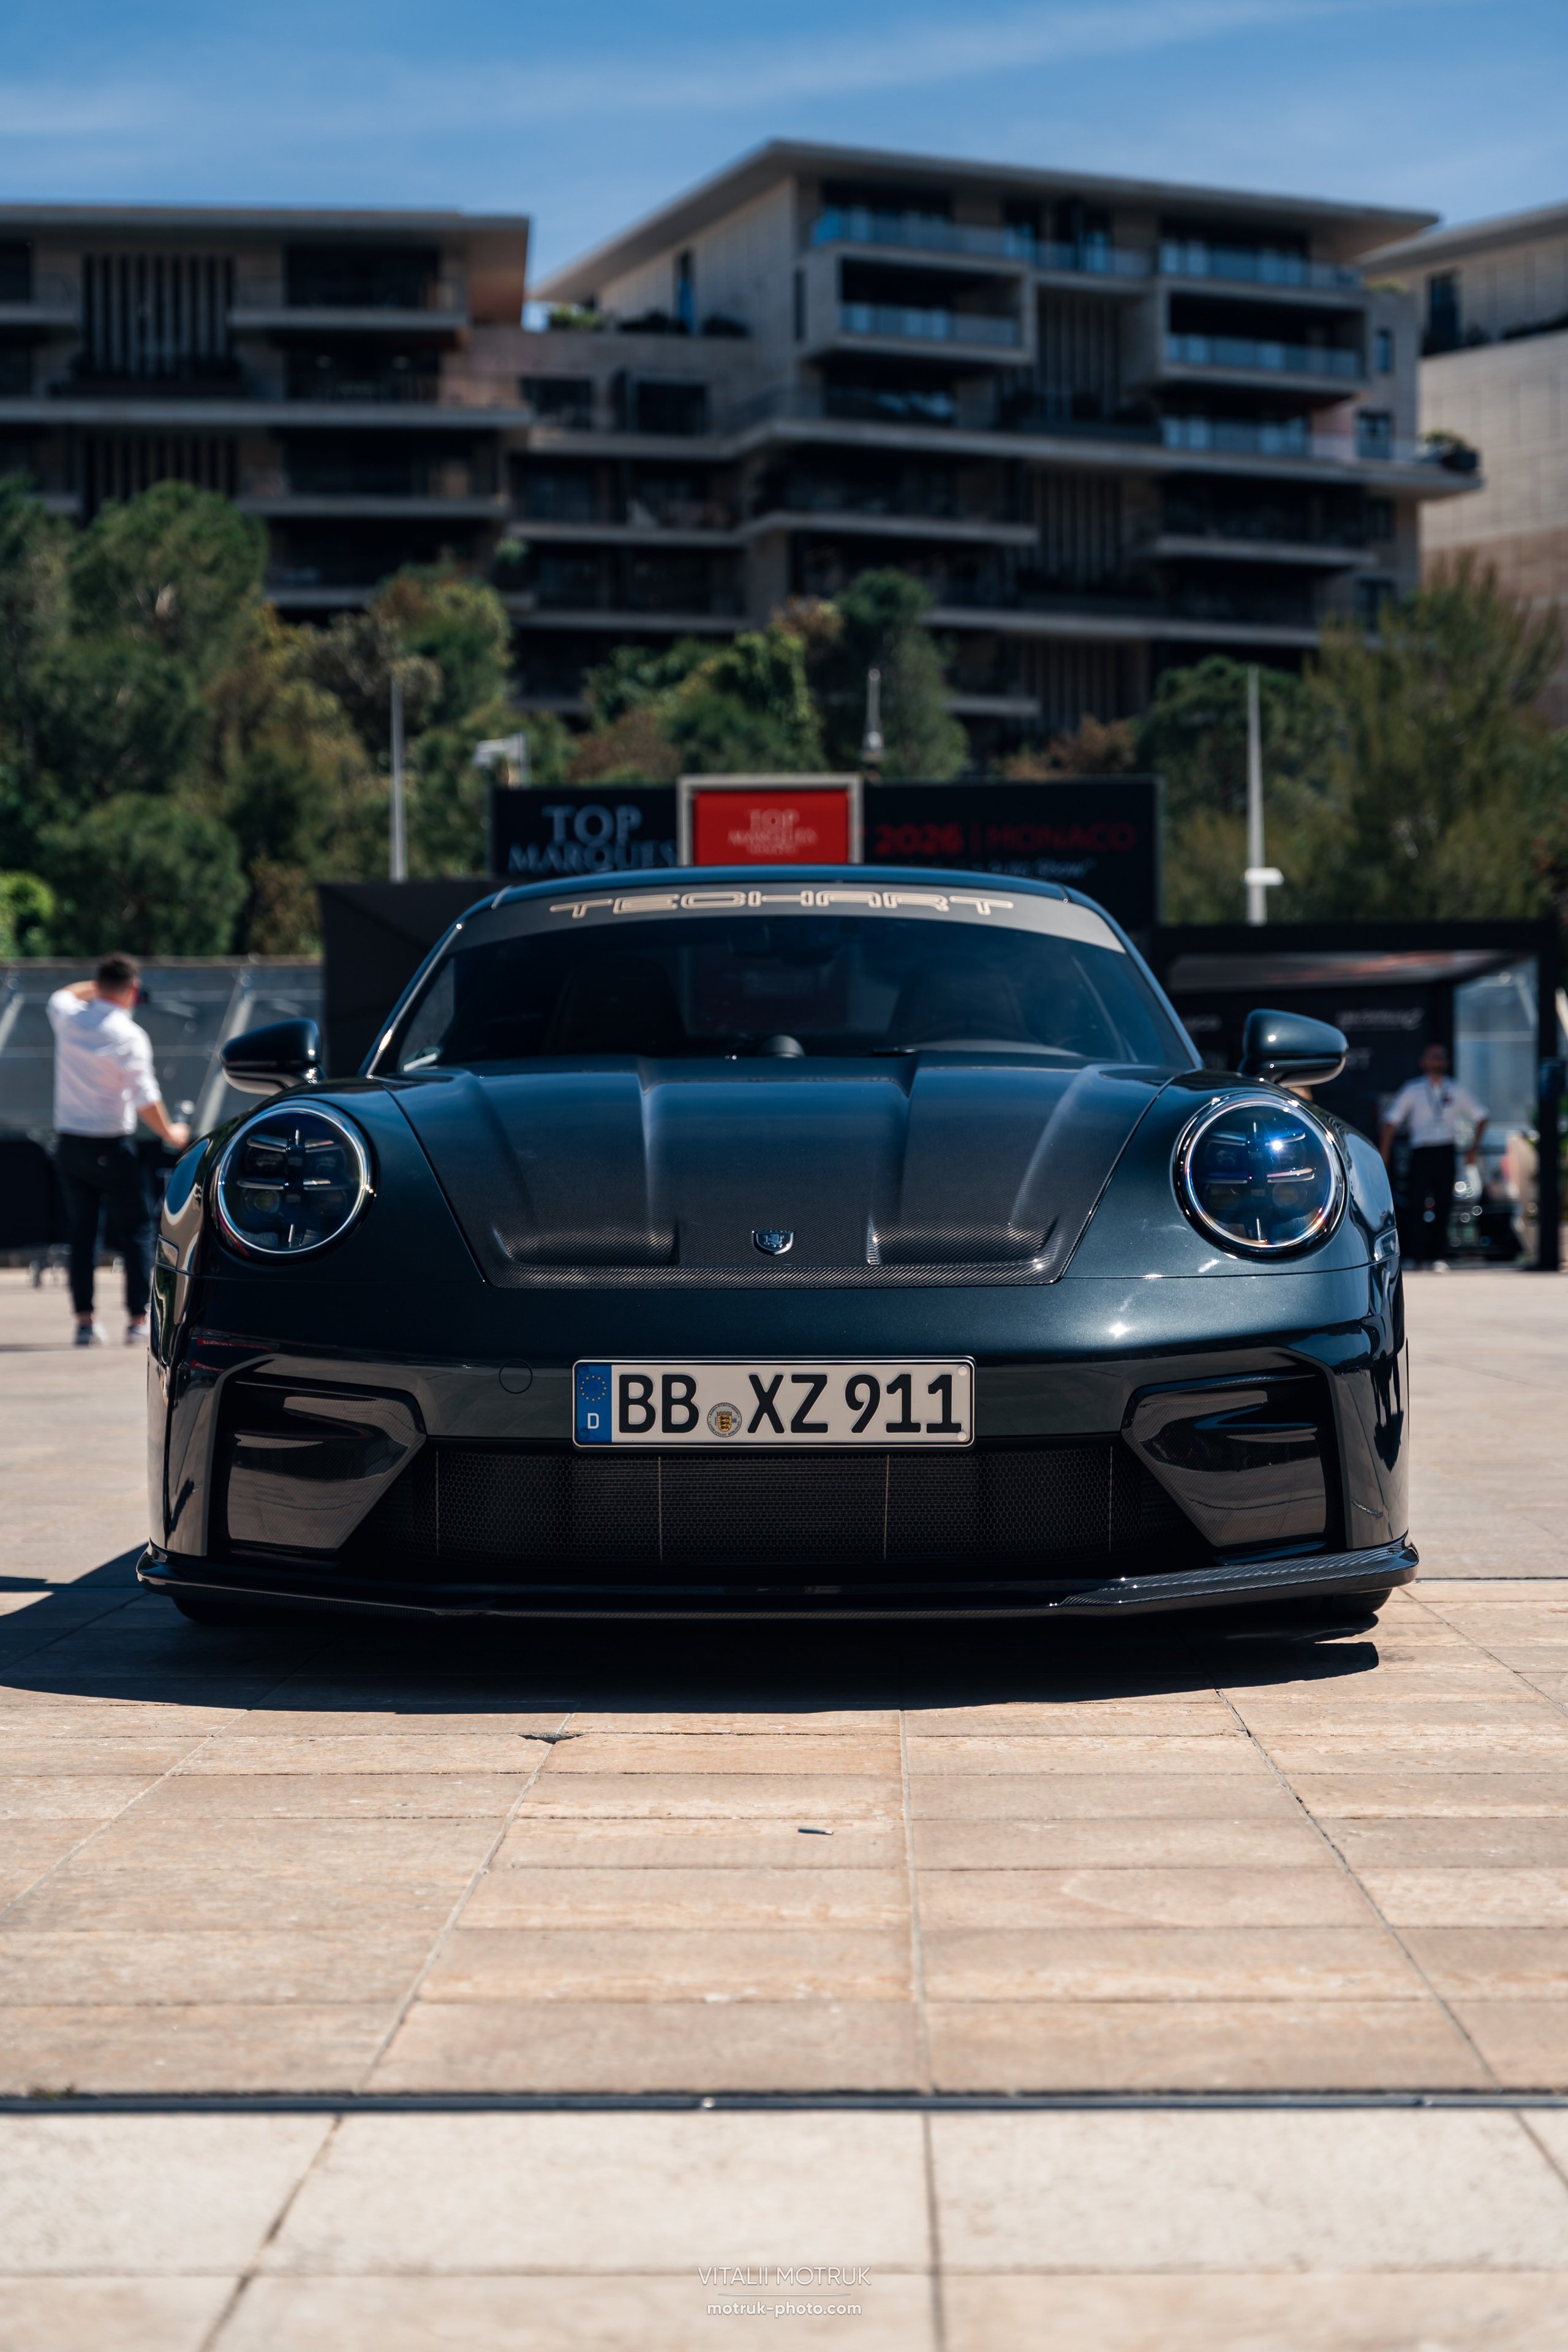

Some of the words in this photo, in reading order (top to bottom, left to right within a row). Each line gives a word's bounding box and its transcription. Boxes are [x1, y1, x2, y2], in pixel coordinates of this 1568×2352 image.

[542, 804, 643, 845] TOP
[873, 822, 965, 857] 2026
[986, 821, 1137, 852] MONACO
[550, 891, 1014, 919] TECHART
[587, 1412, 599, 1429] D
[619, 1374, 699, 1433] BB
[747, 1374, 829, 1433] XZ
[845, 1374, 962, 1433] 911
